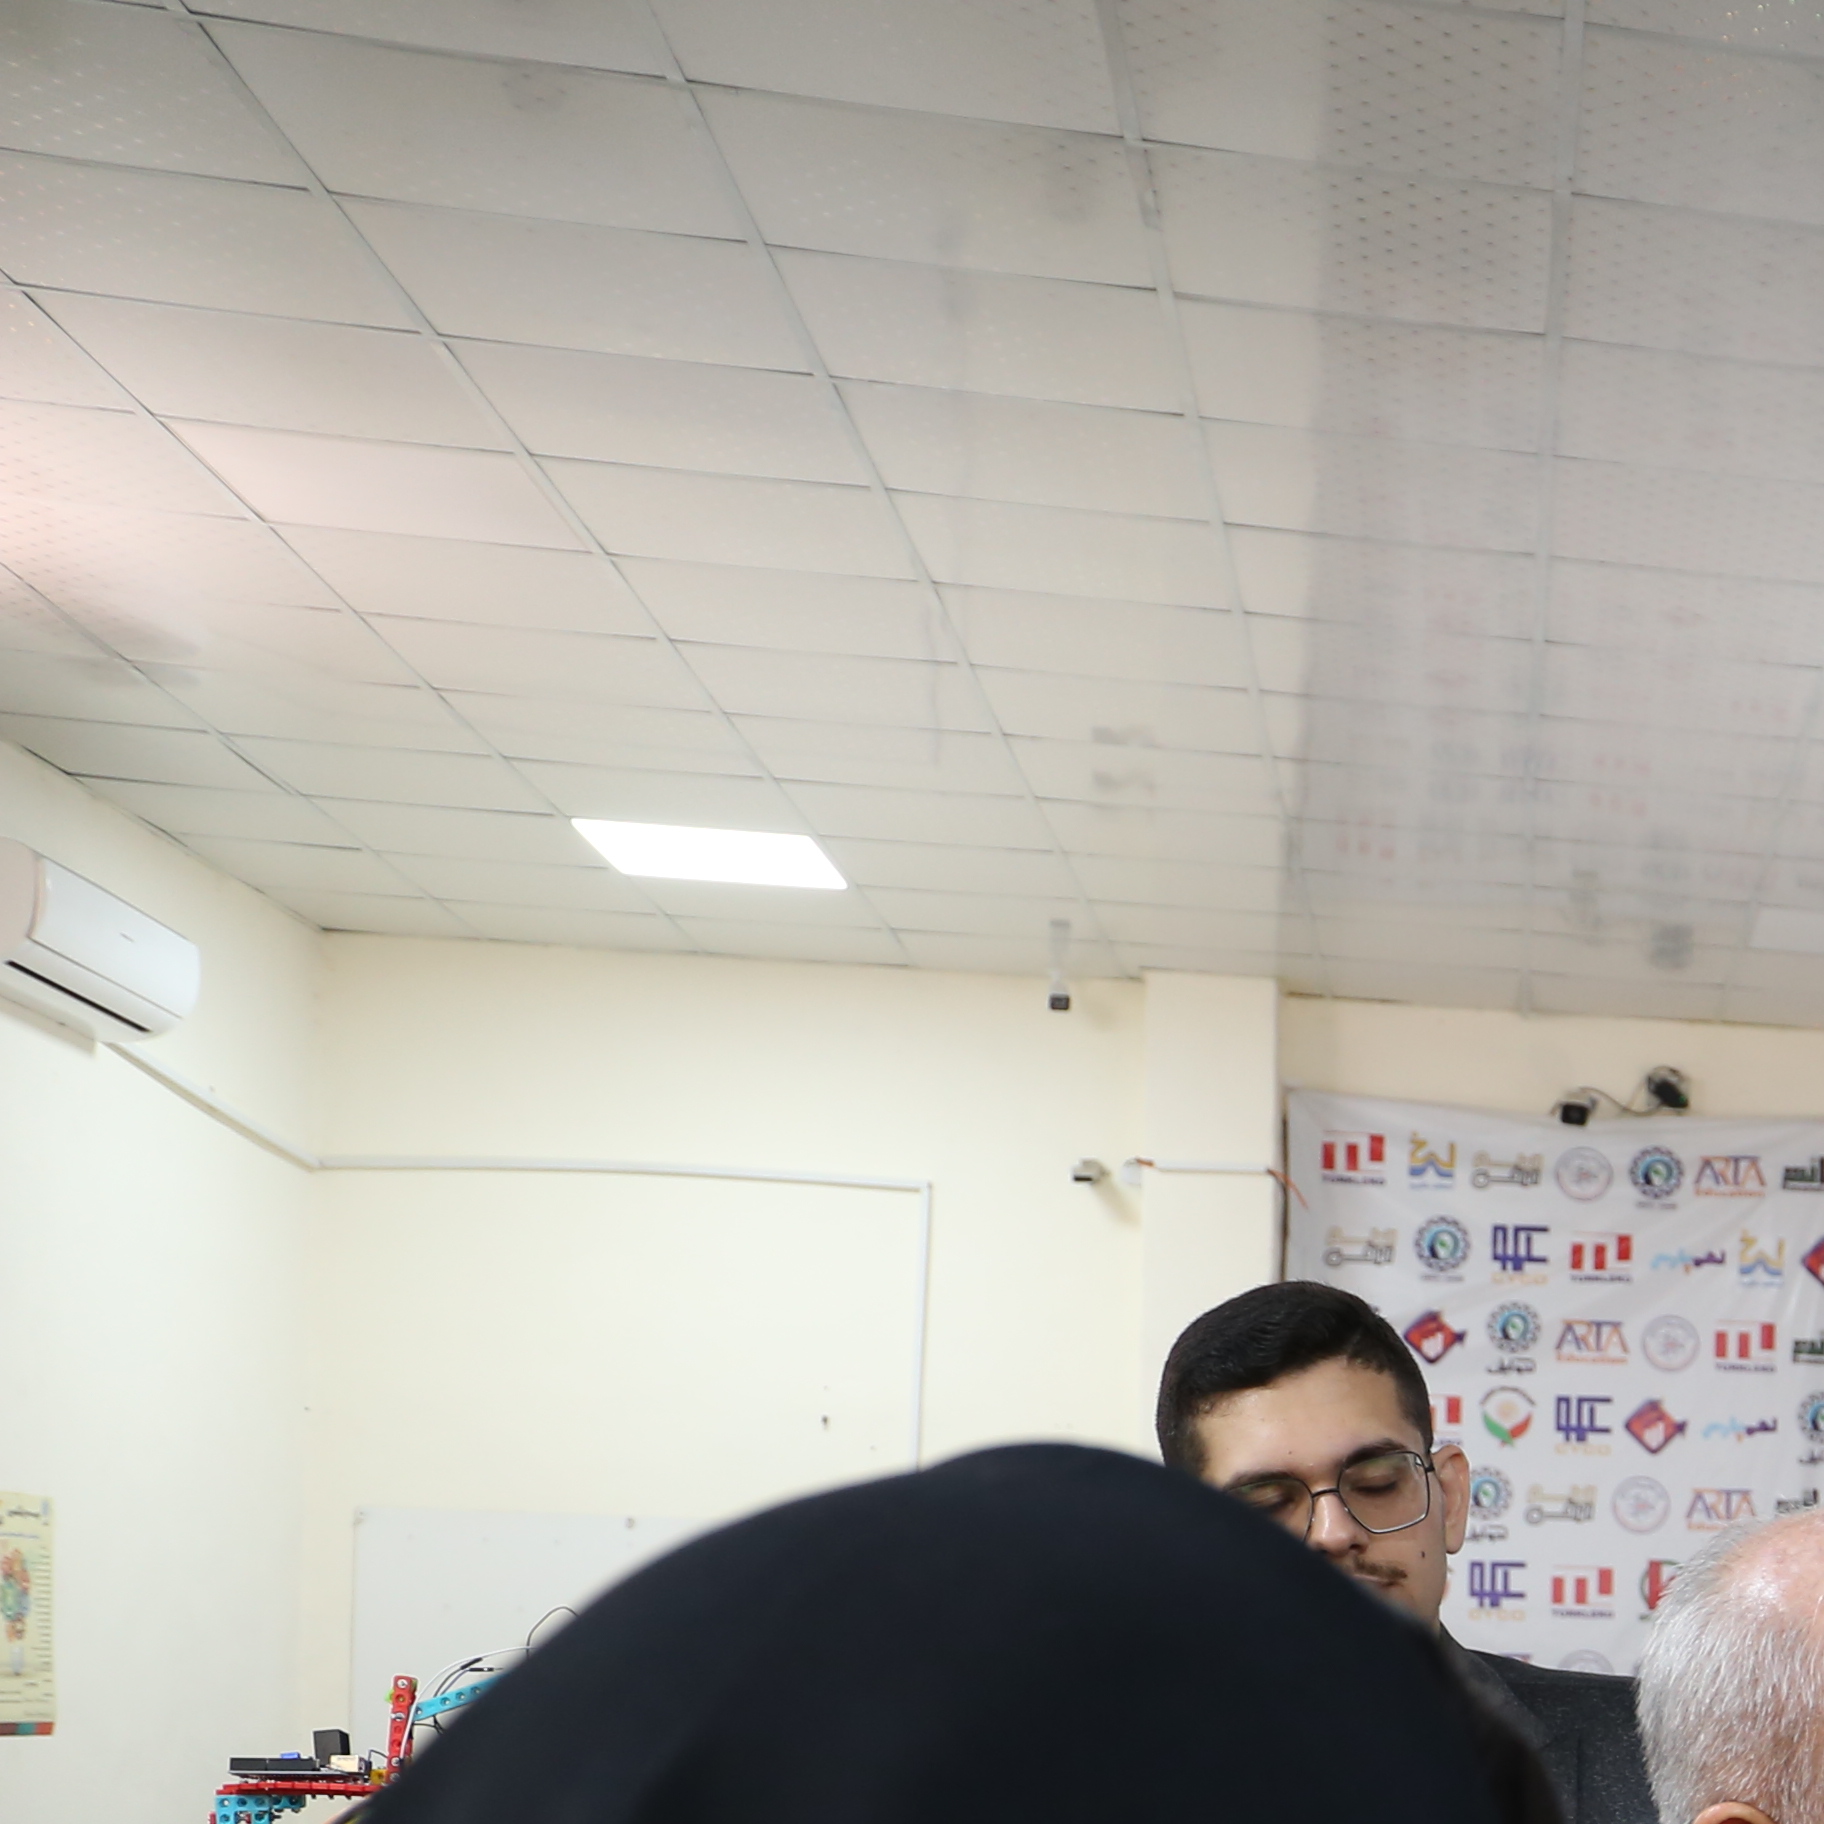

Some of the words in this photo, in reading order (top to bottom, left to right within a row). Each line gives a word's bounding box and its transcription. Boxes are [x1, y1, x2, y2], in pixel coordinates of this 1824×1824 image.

[1695, 1155, 1767, 1188] ARTA
[1555, 1319, 1630, 1355] ARTA
[1687, 1487, 1757, 1520] ARTA
